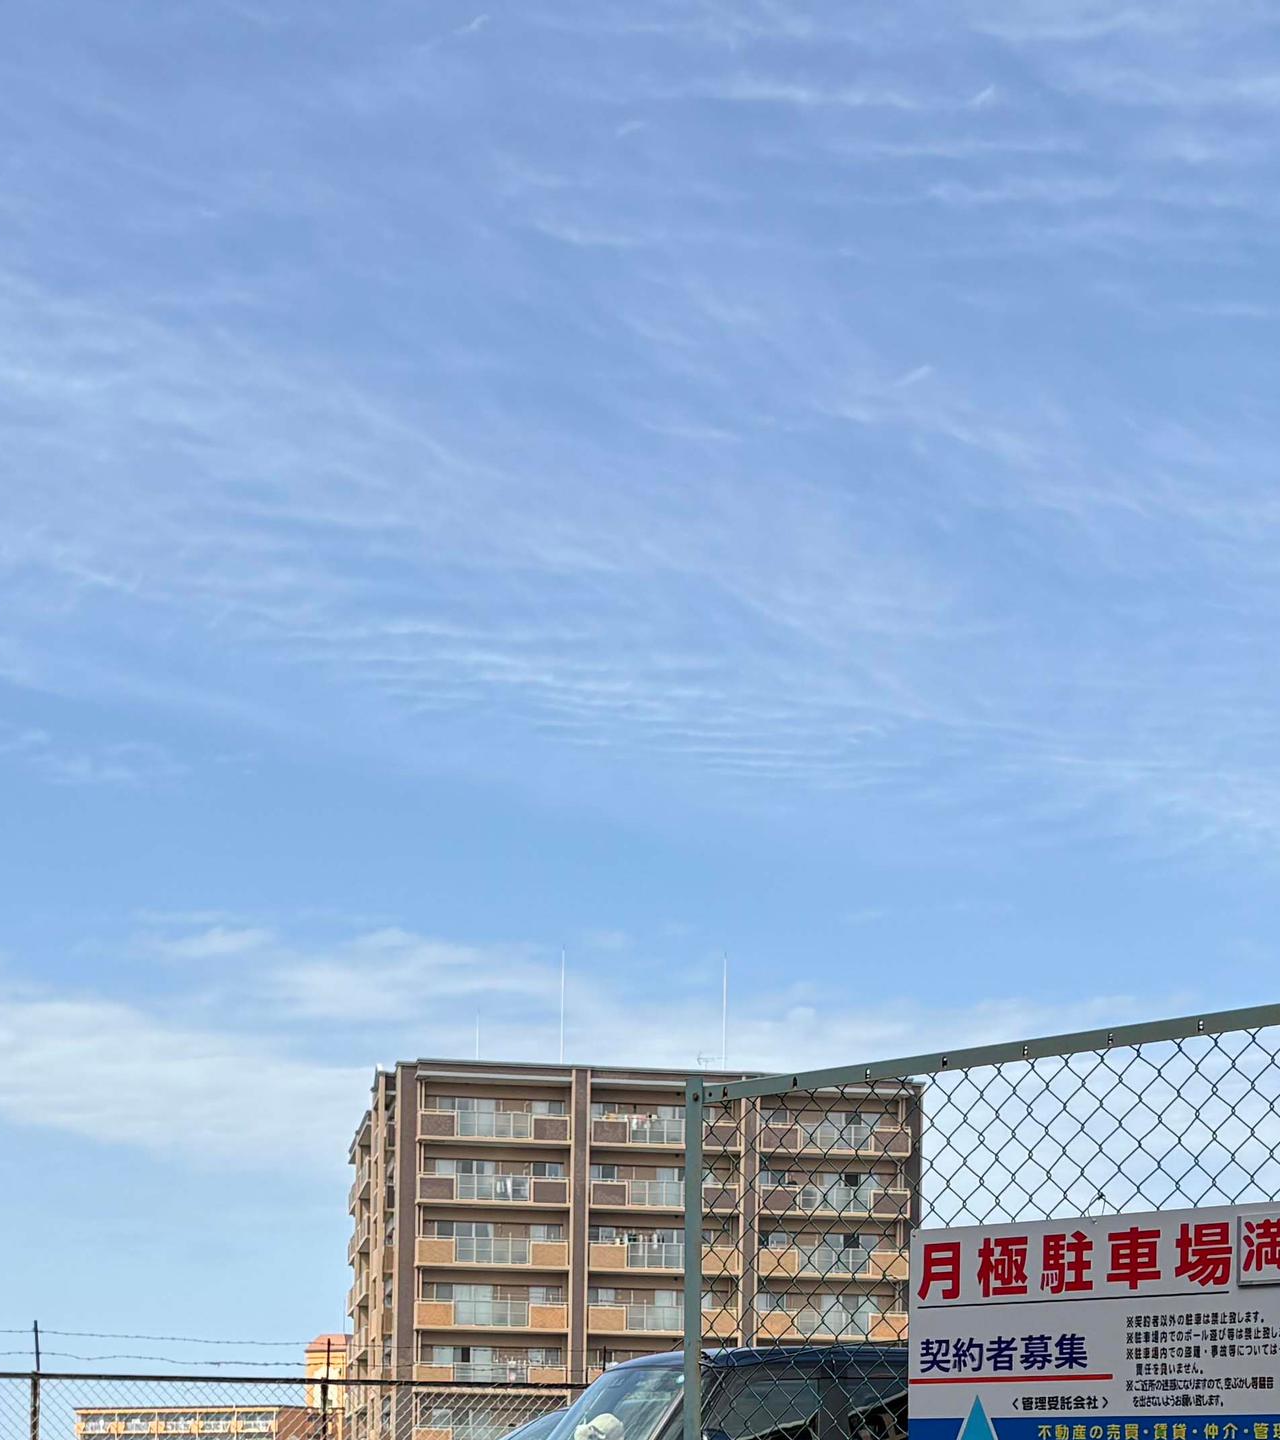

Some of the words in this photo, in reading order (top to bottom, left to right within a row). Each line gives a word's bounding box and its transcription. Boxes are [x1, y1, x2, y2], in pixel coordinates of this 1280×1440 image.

[917, 1222, 1233, 1301] 月極駐車場
[920, 1333, 1088, 1373] 契約者募集
